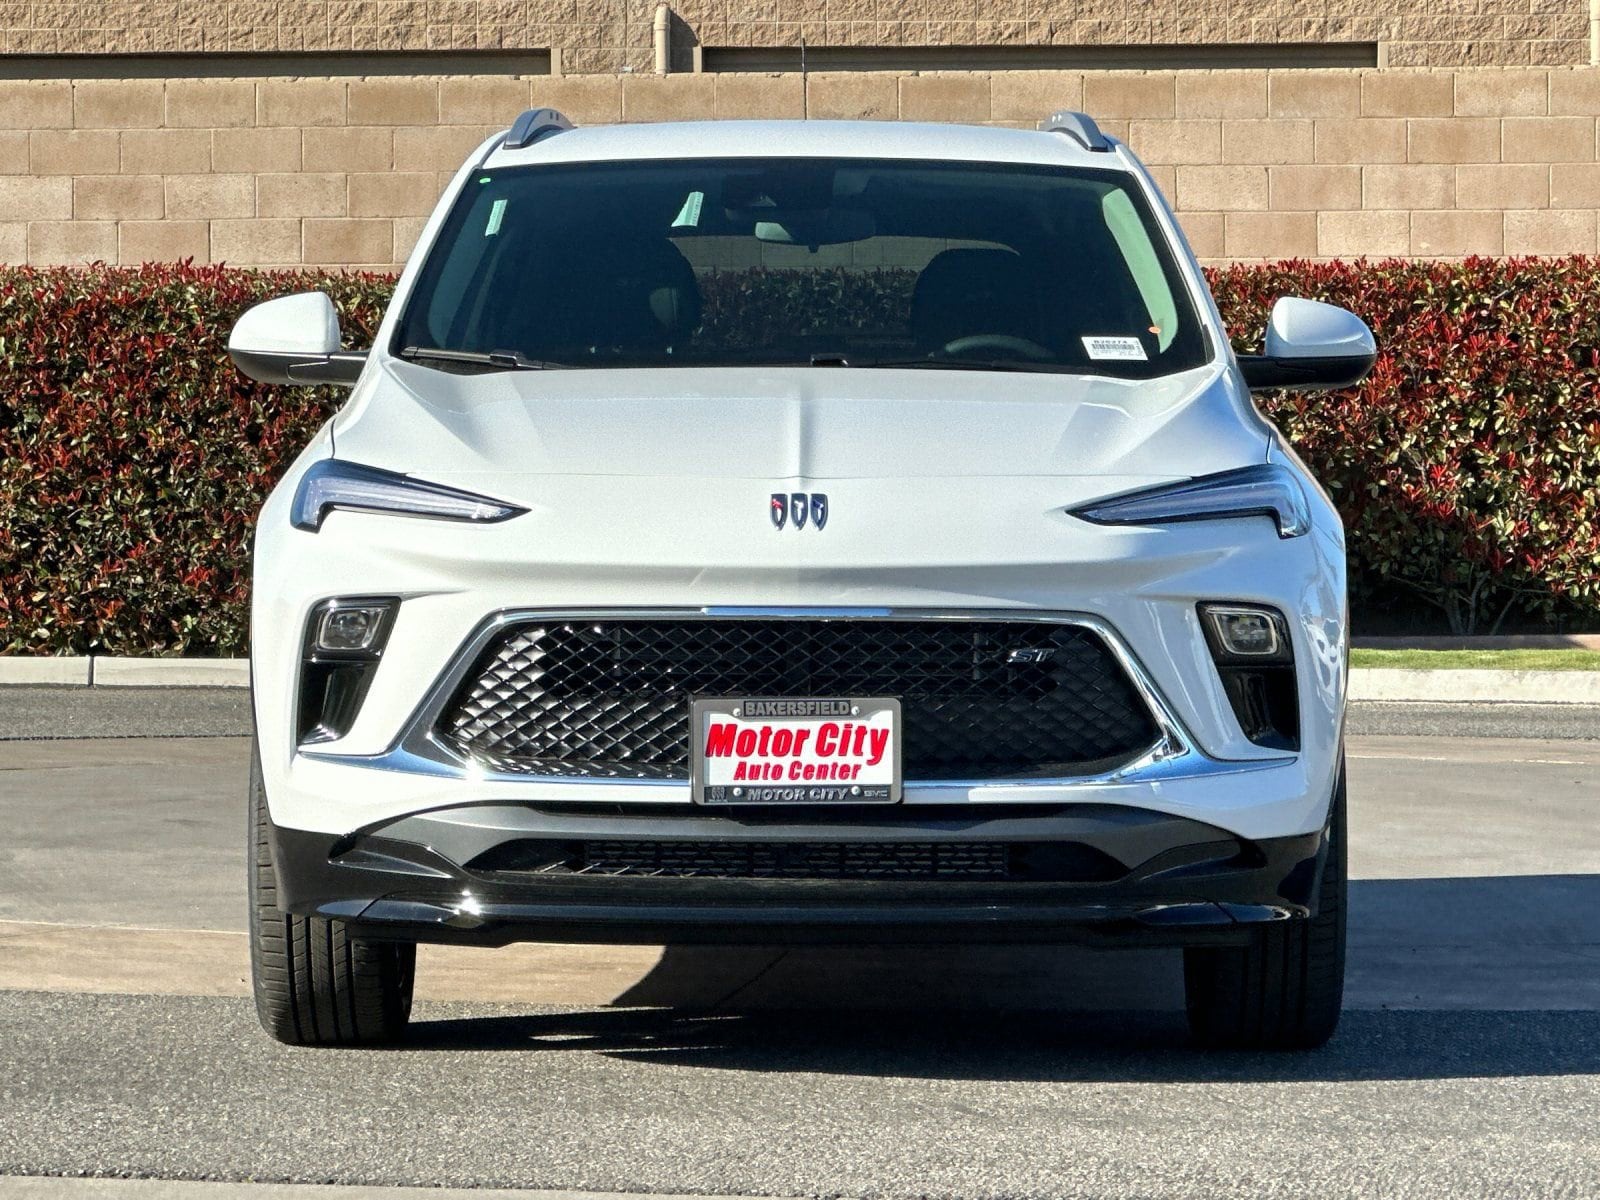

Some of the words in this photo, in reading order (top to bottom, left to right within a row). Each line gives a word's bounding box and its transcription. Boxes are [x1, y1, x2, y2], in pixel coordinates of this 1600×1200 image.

[745, 701, 849, 716] BAKERSFIELD
[705, 723, 811, 758] Motor
[815, 722, 889, 765] City
[733, 761, 783, 780] Auto
[788, 760, 861, 780] Center
[748, 788, 806, 801] MOTOR
[809, 787, 849, 800] CITY
[864, 789, 888, 798] GMC
